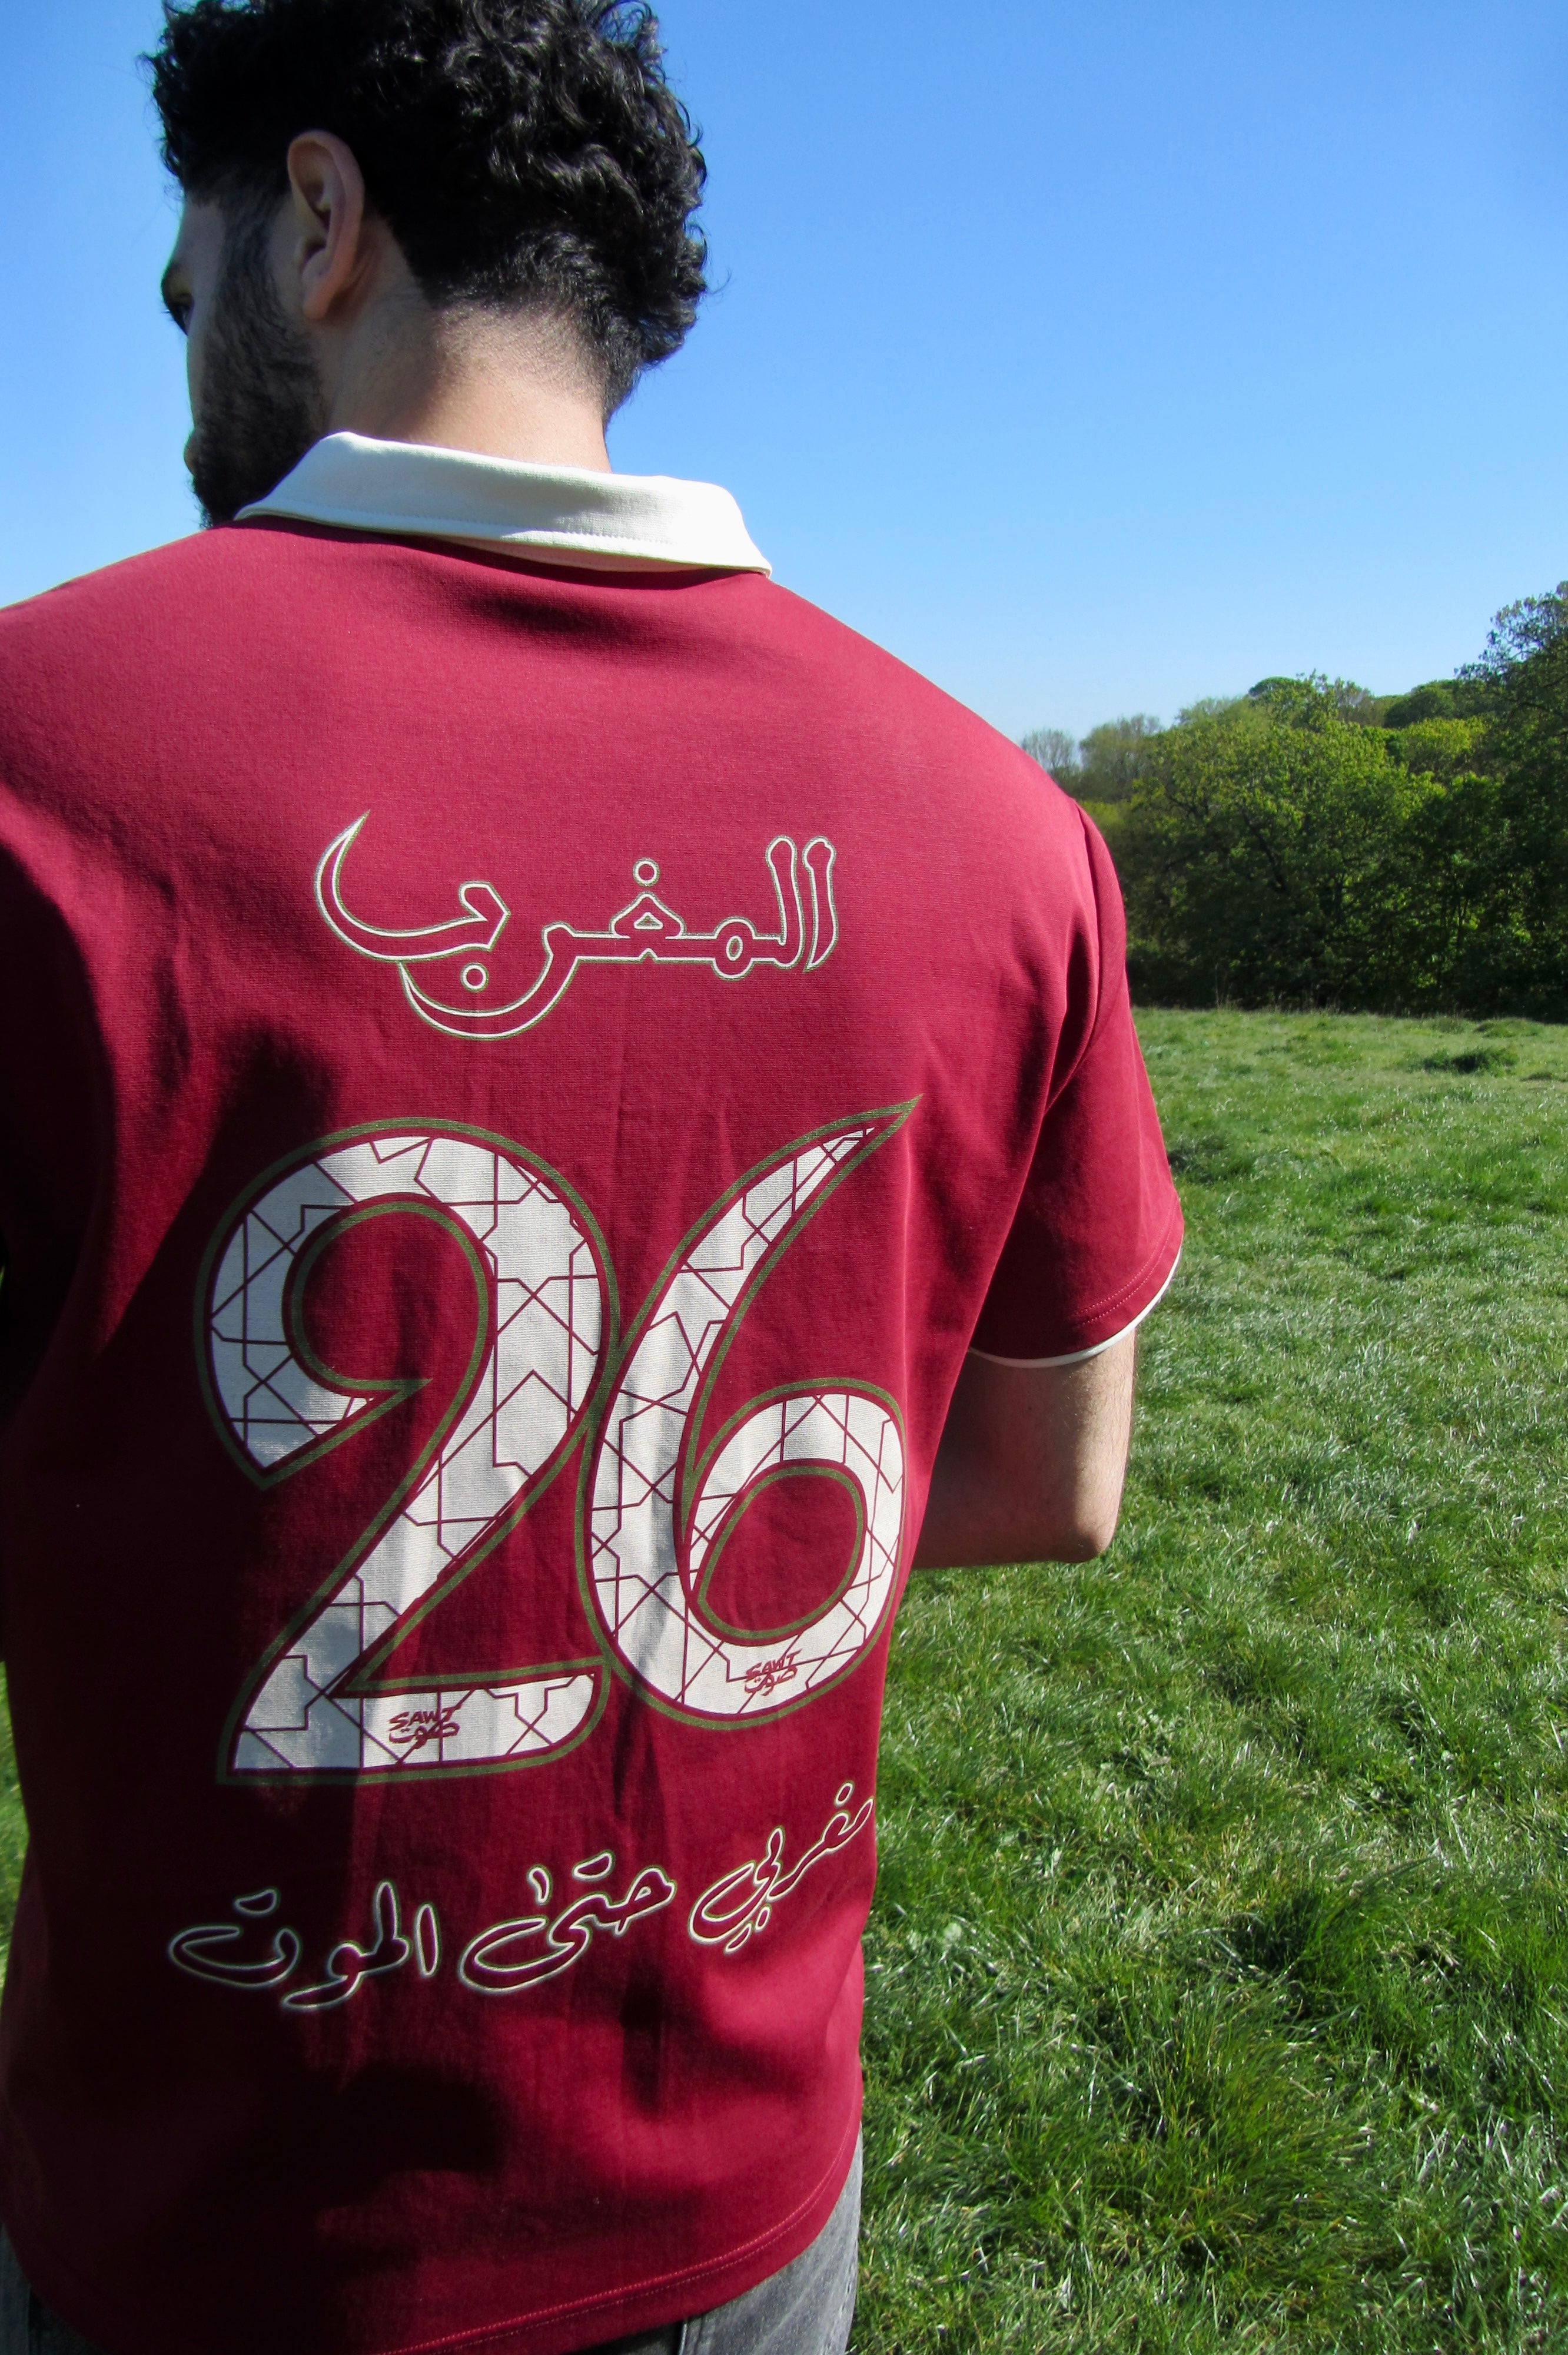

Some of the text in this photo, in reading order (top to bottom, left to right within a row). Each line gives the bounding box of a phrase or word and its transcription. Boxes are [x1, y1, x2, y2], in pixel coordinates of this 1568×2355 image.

[314, 809, 839, 1041] المغرب
[193, 1094, 923, 1786] 26
[388, 1706, 461, 1732] SAWT
[744, 1648, 802, 1683] SAWT
[167, 1879, 441, 2012] الموت
